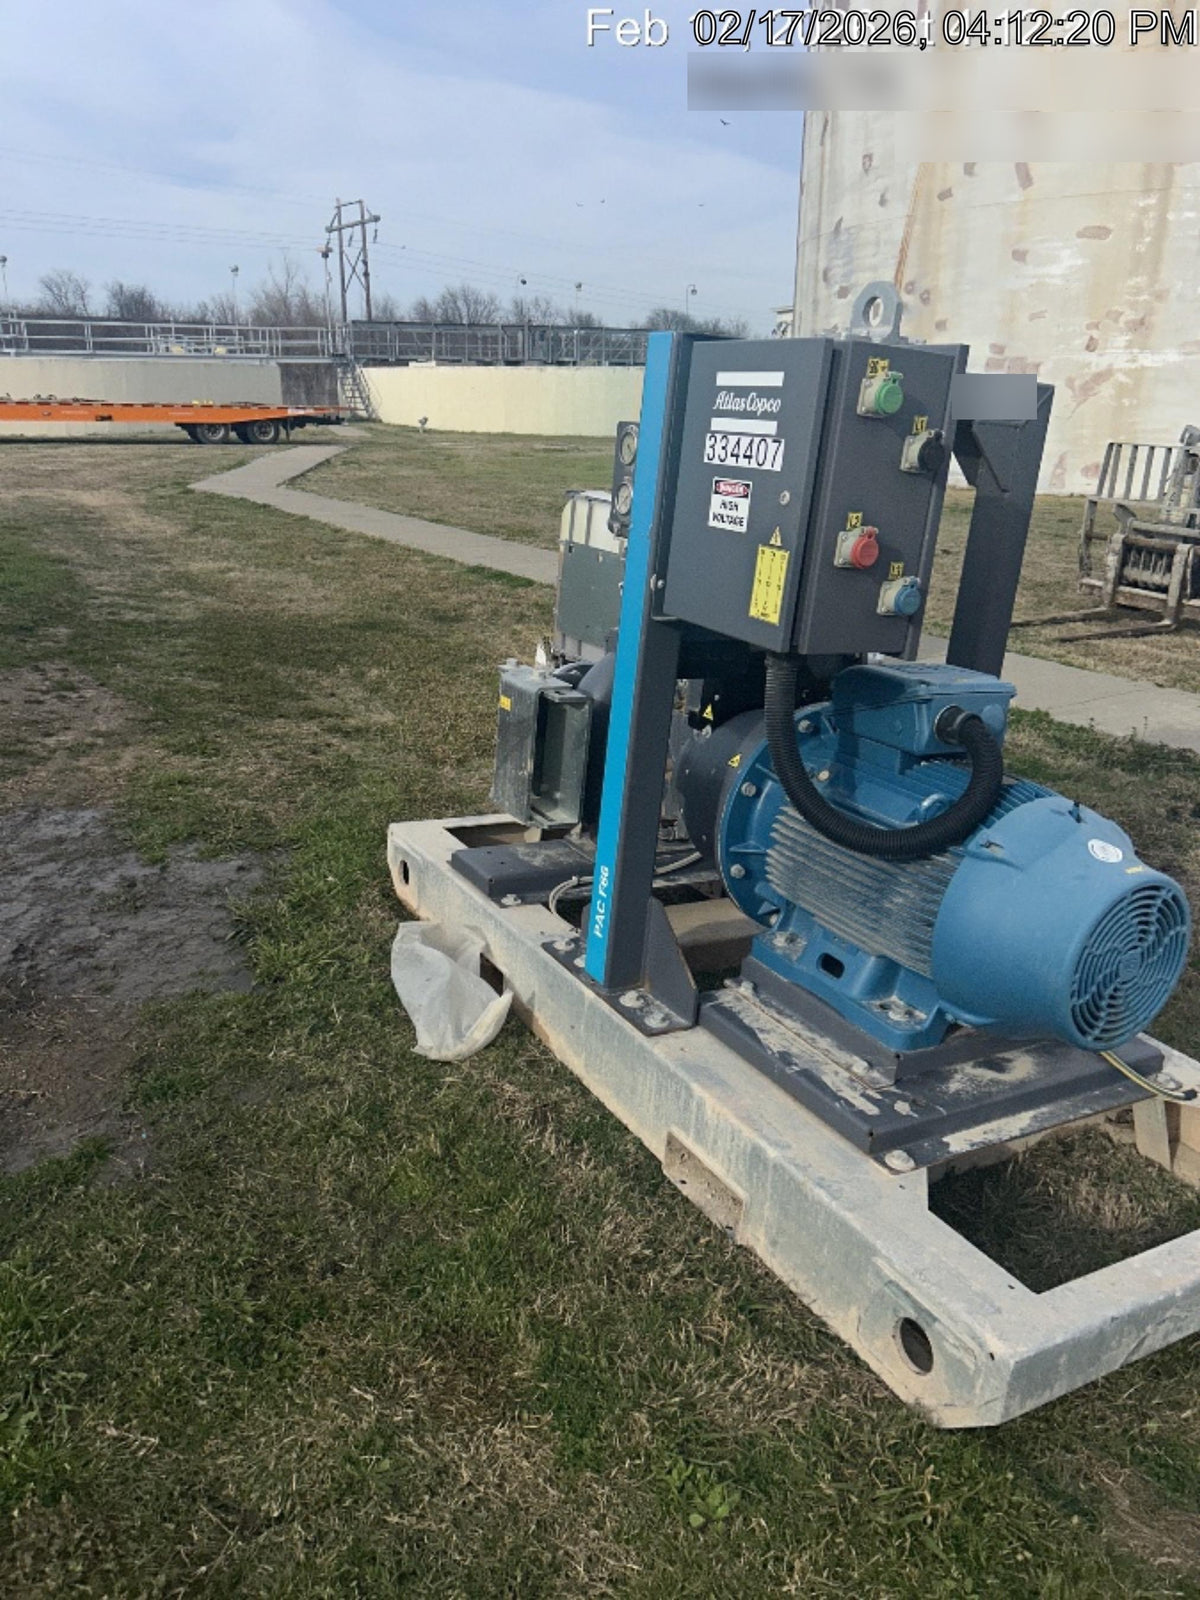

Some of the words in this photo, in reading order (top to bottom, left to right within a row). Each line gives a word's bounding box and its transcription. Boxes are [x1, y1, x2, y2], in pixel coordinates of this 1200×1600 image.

[712, 390, 747, 411] Atlas
[746, 391, 782, 416] Copco
[706, 434, 783, 469] 334407
[712, 512, 745, 527] VOLTAGE
[594, 899, 606, 938] PAC
